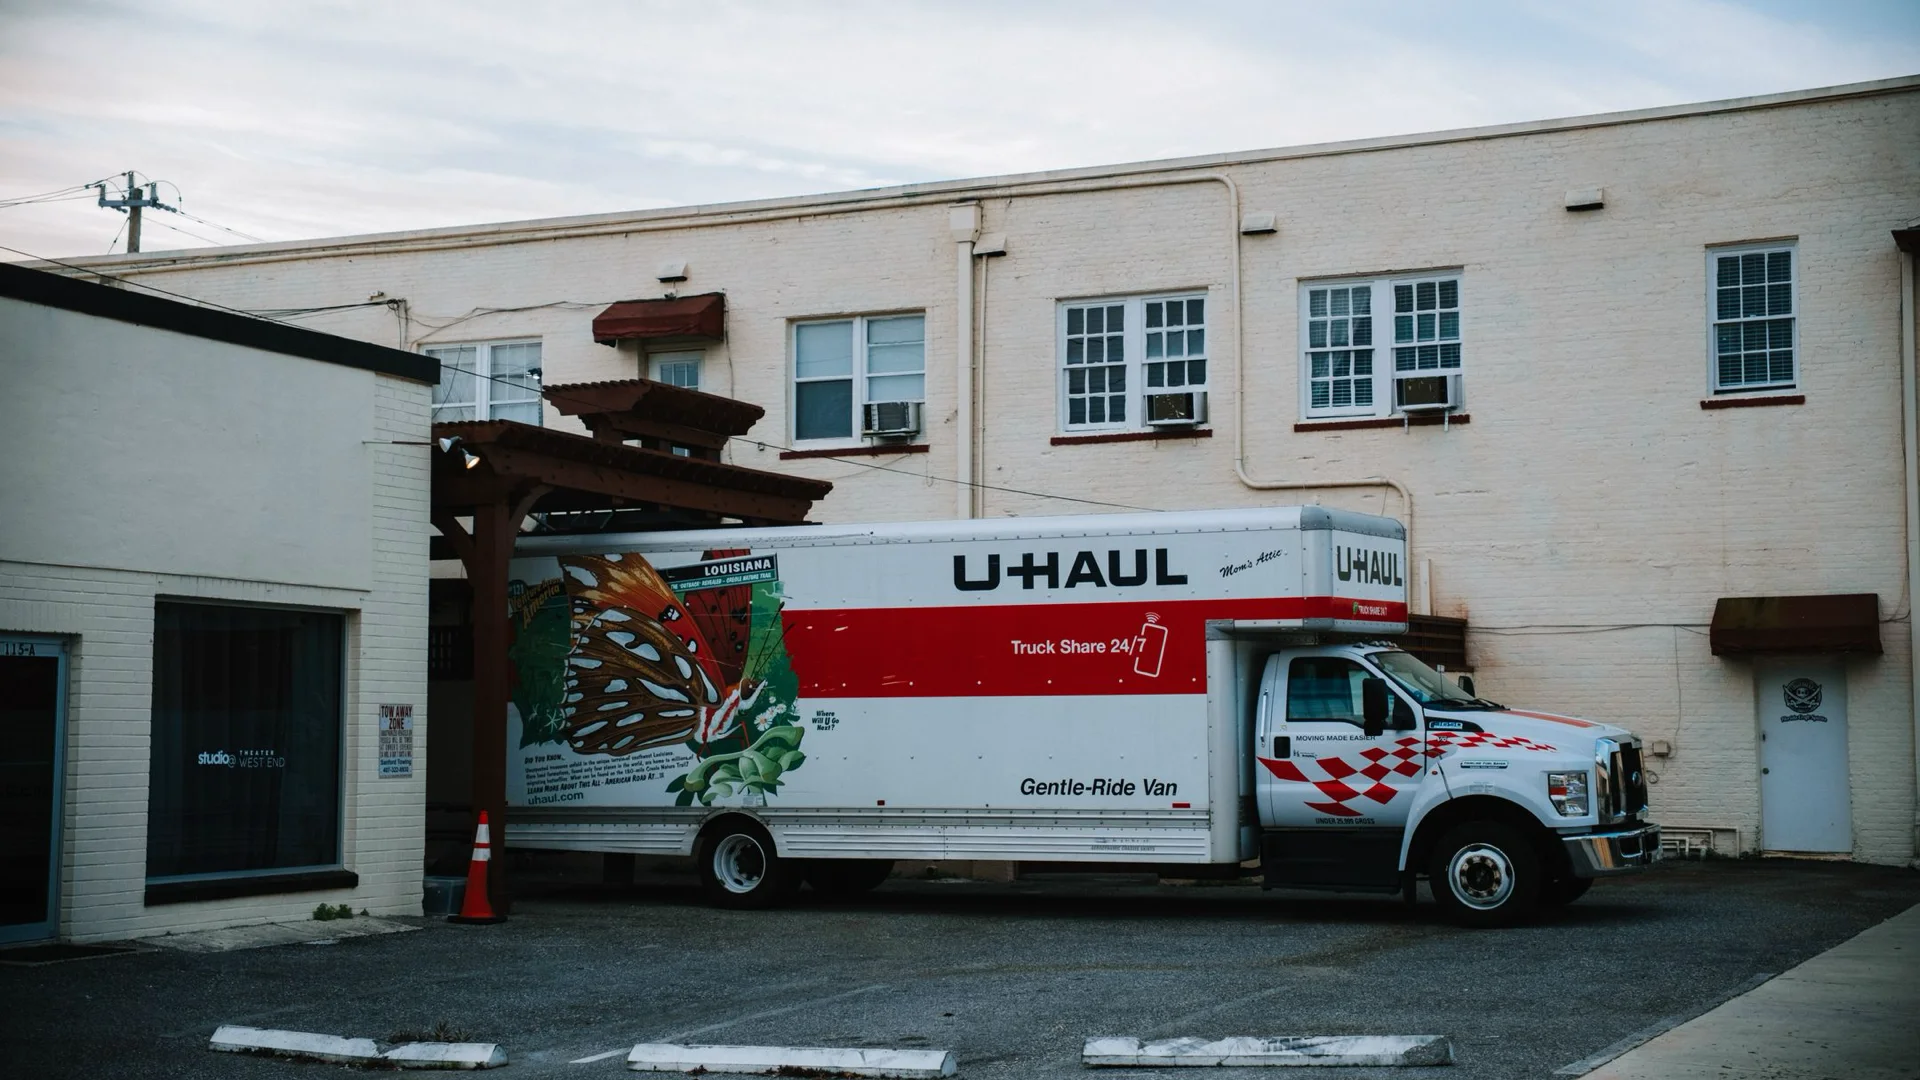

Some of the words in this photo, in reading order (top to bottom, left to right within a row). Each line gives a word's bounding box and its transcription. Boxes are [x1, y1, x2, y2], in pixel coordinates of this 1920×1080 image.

[704, 559, 771, 576] LOUISIANA
[953, 548, 1188, 591] U-HAUL
[1220, 559, 1253, 579] Mom's
[1256, 549, 1282, 567] Attic
[1337, 545, 1403, 587] U-HAUL
[6, 642, 35, 655] 115-A
[1011, 639, 1055, 656] Truck
[1059, 639, 1106, 654] Share
[1110, 635, 1147, 656] 24/7
[381, 705, 394, 717] TOW
[396, 705, 412, 717] AWAY
[389, 718, 404, 729] ZONE
[825, 717, 831, 725] U
[239, 757, 264, 768] WEST
[267, 757, 285, 768] END
[1020, 778, 1136, 796] Gentle-Ride
[1144, 778, 1177, 796] Van
[528, 791, 584, 805] uhaul.com
